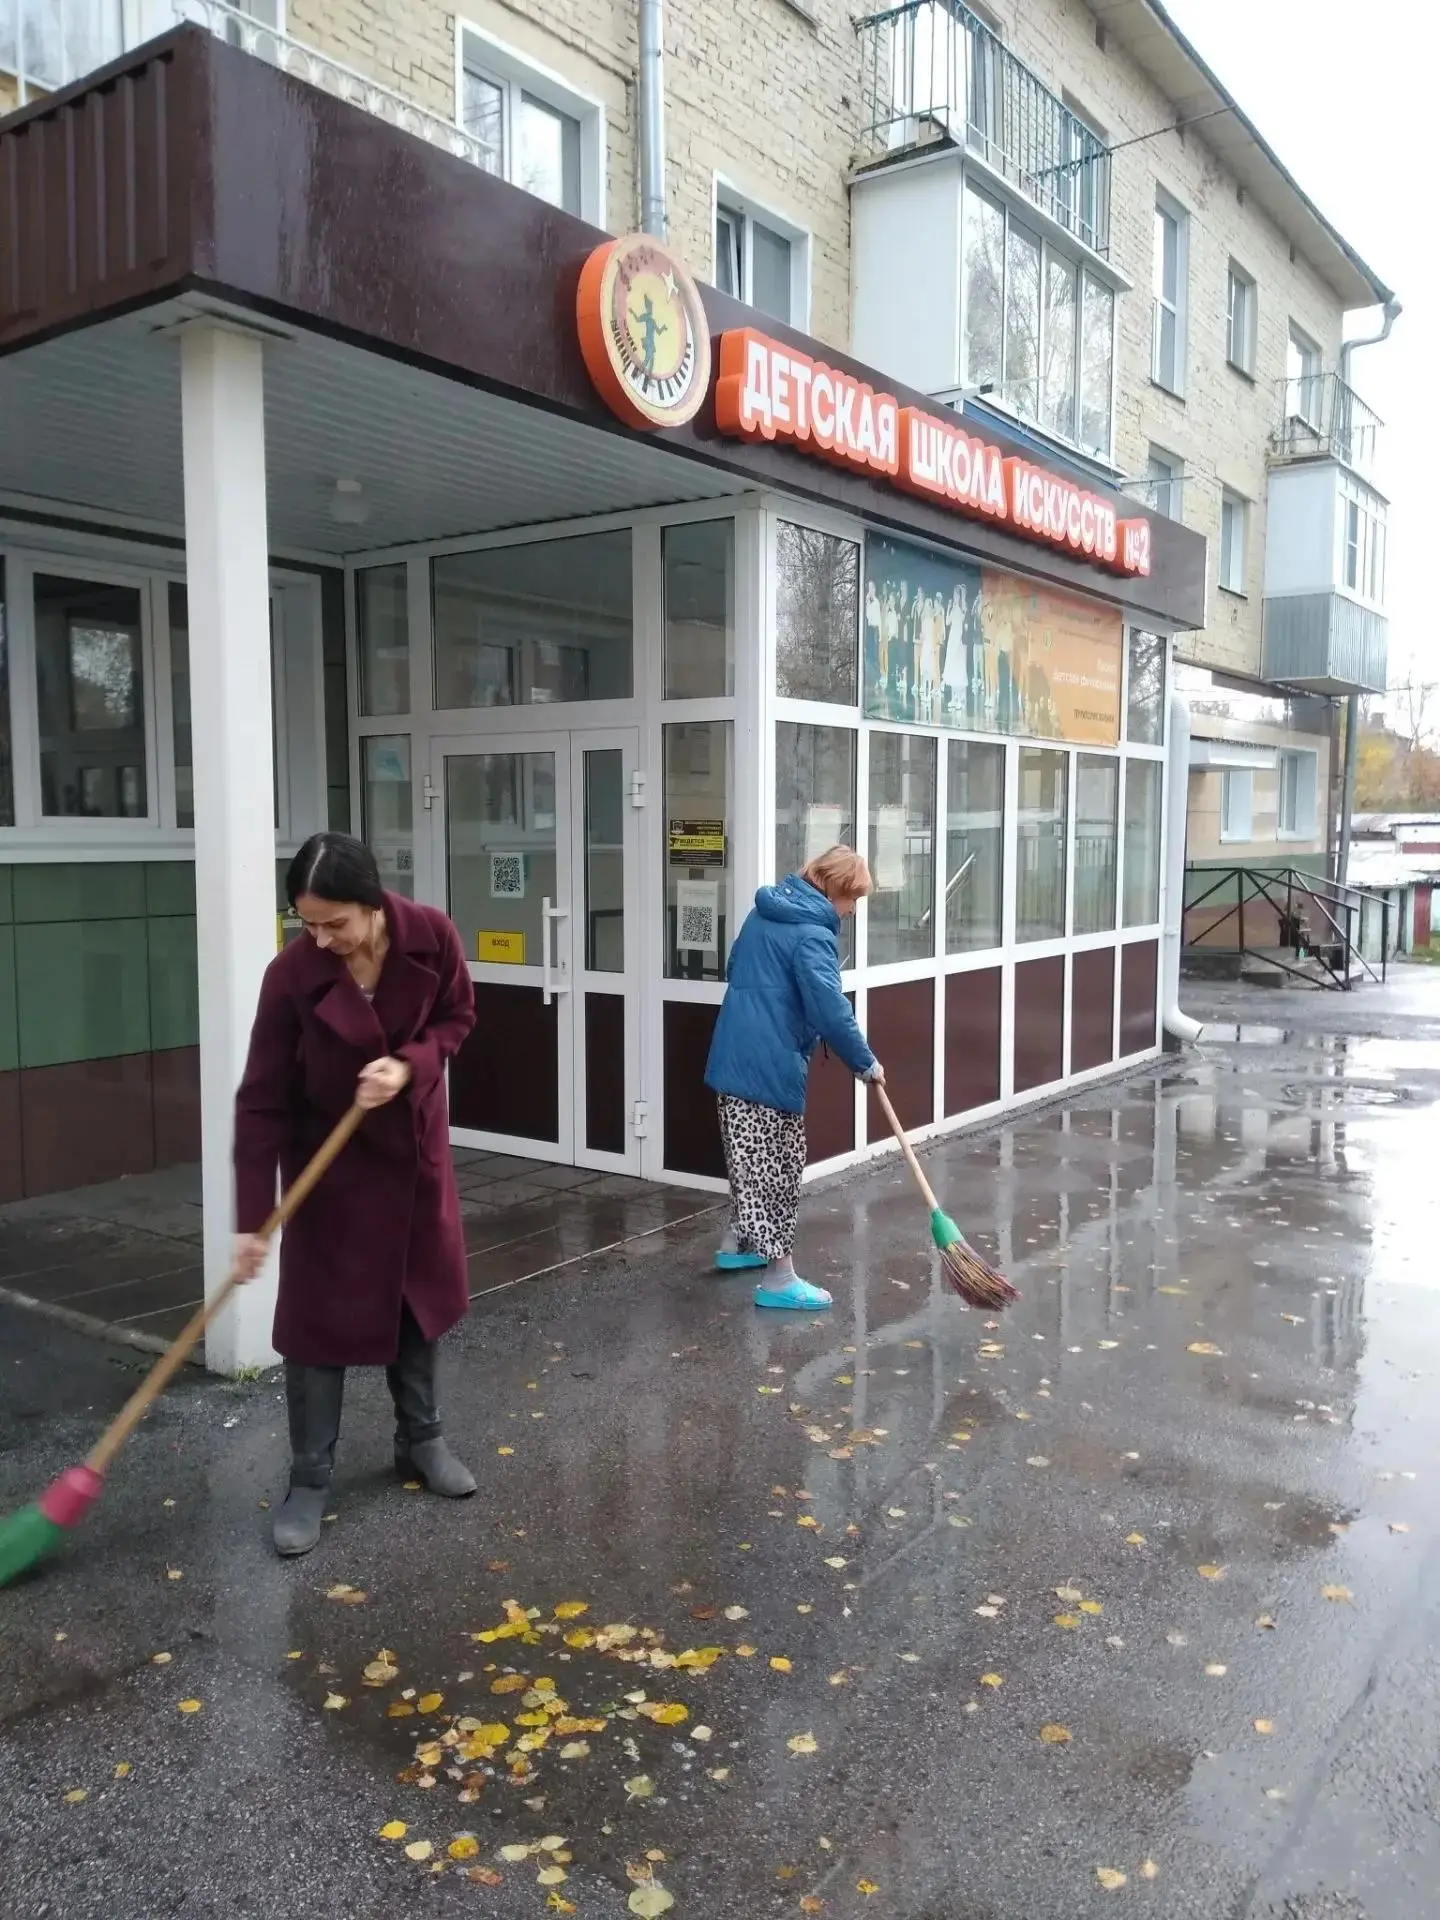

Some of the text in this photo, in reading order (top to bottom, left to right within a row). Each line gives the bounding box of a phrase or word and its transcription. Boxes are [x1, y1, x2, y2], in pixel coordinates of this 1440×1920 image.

[743, 339, 1150, 569] ДЕТСКАЯ ШКОЛА ИСКУССТВ №2
